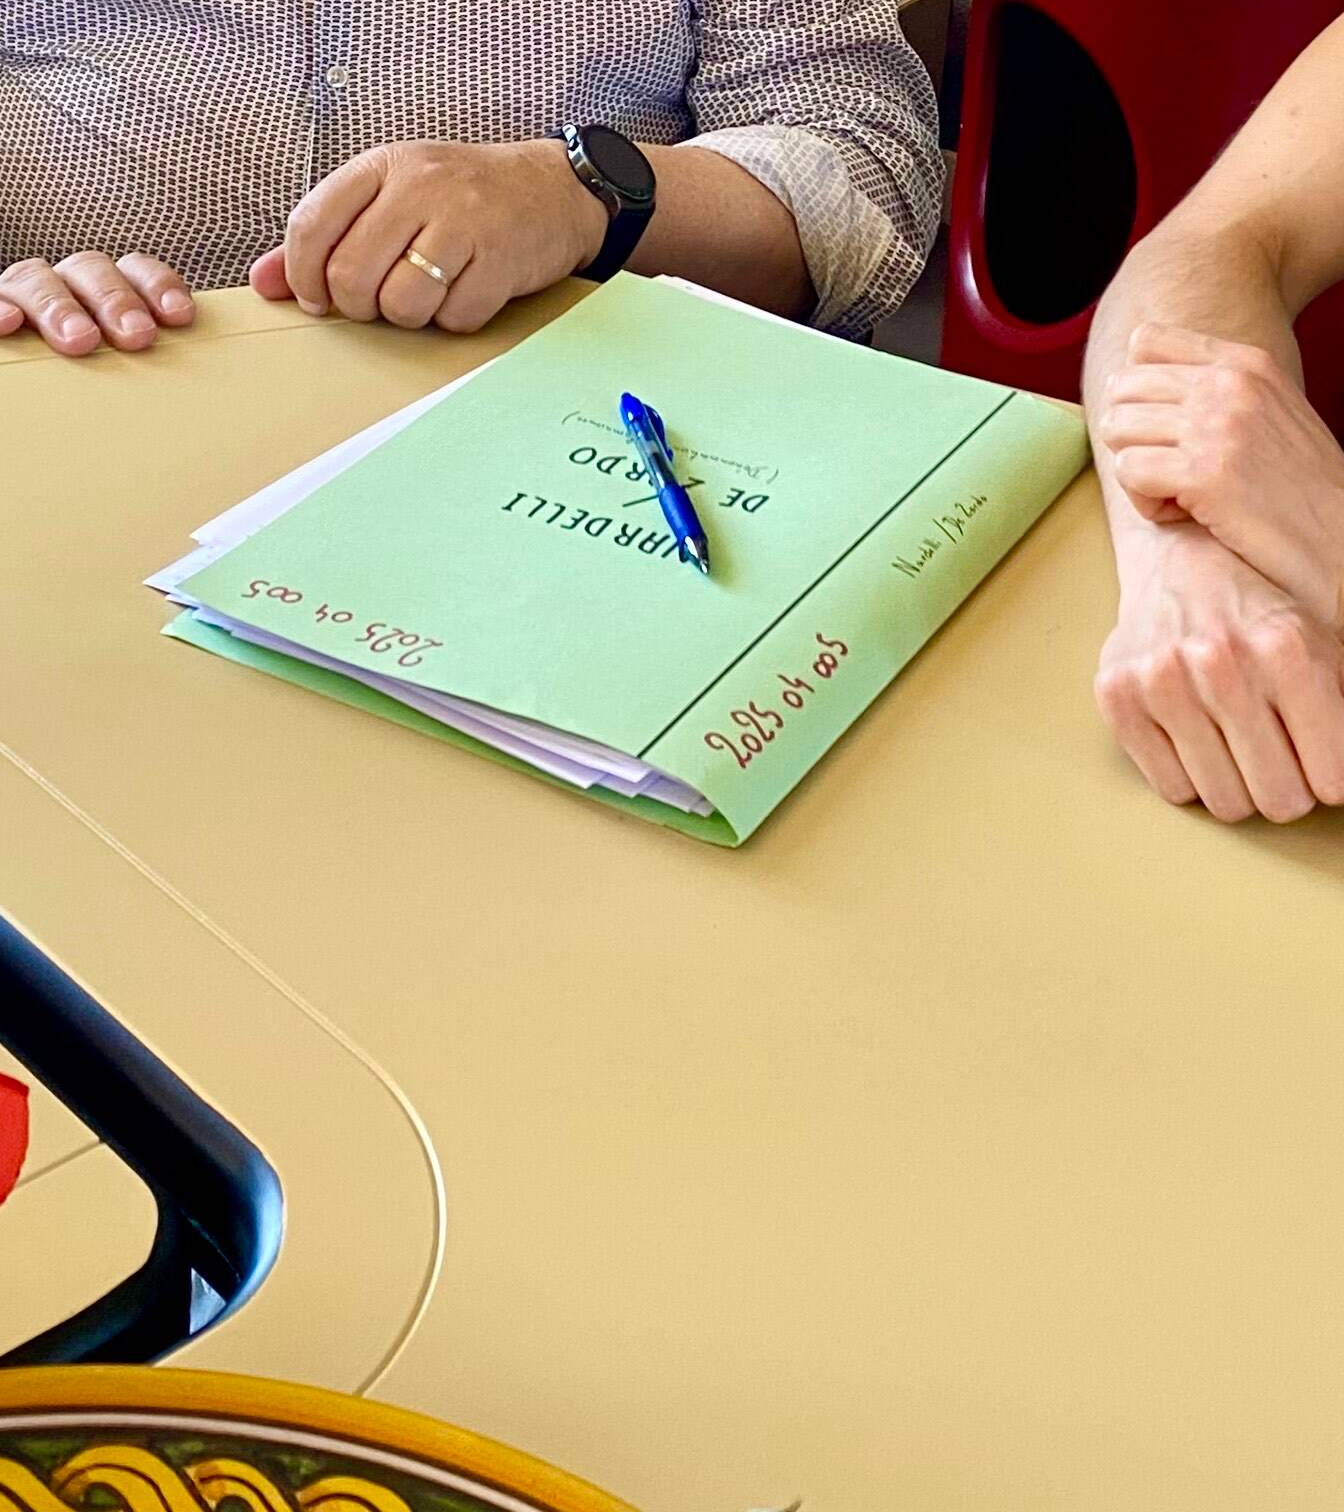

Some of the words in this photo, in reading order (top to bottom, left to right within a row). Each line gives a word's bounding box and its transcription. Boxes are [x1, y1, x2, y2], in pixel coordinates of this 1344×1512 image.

[719, 487, 770, 514] DE
[241, 580, 303, 604] 005
[314, 603, 353, 624] 04
[353, 621, 444, 667] 2025
[703, 700, 784, 769] 2025
[776, 673, 816, 710] 04
[812, 631, 849, 679] 005
